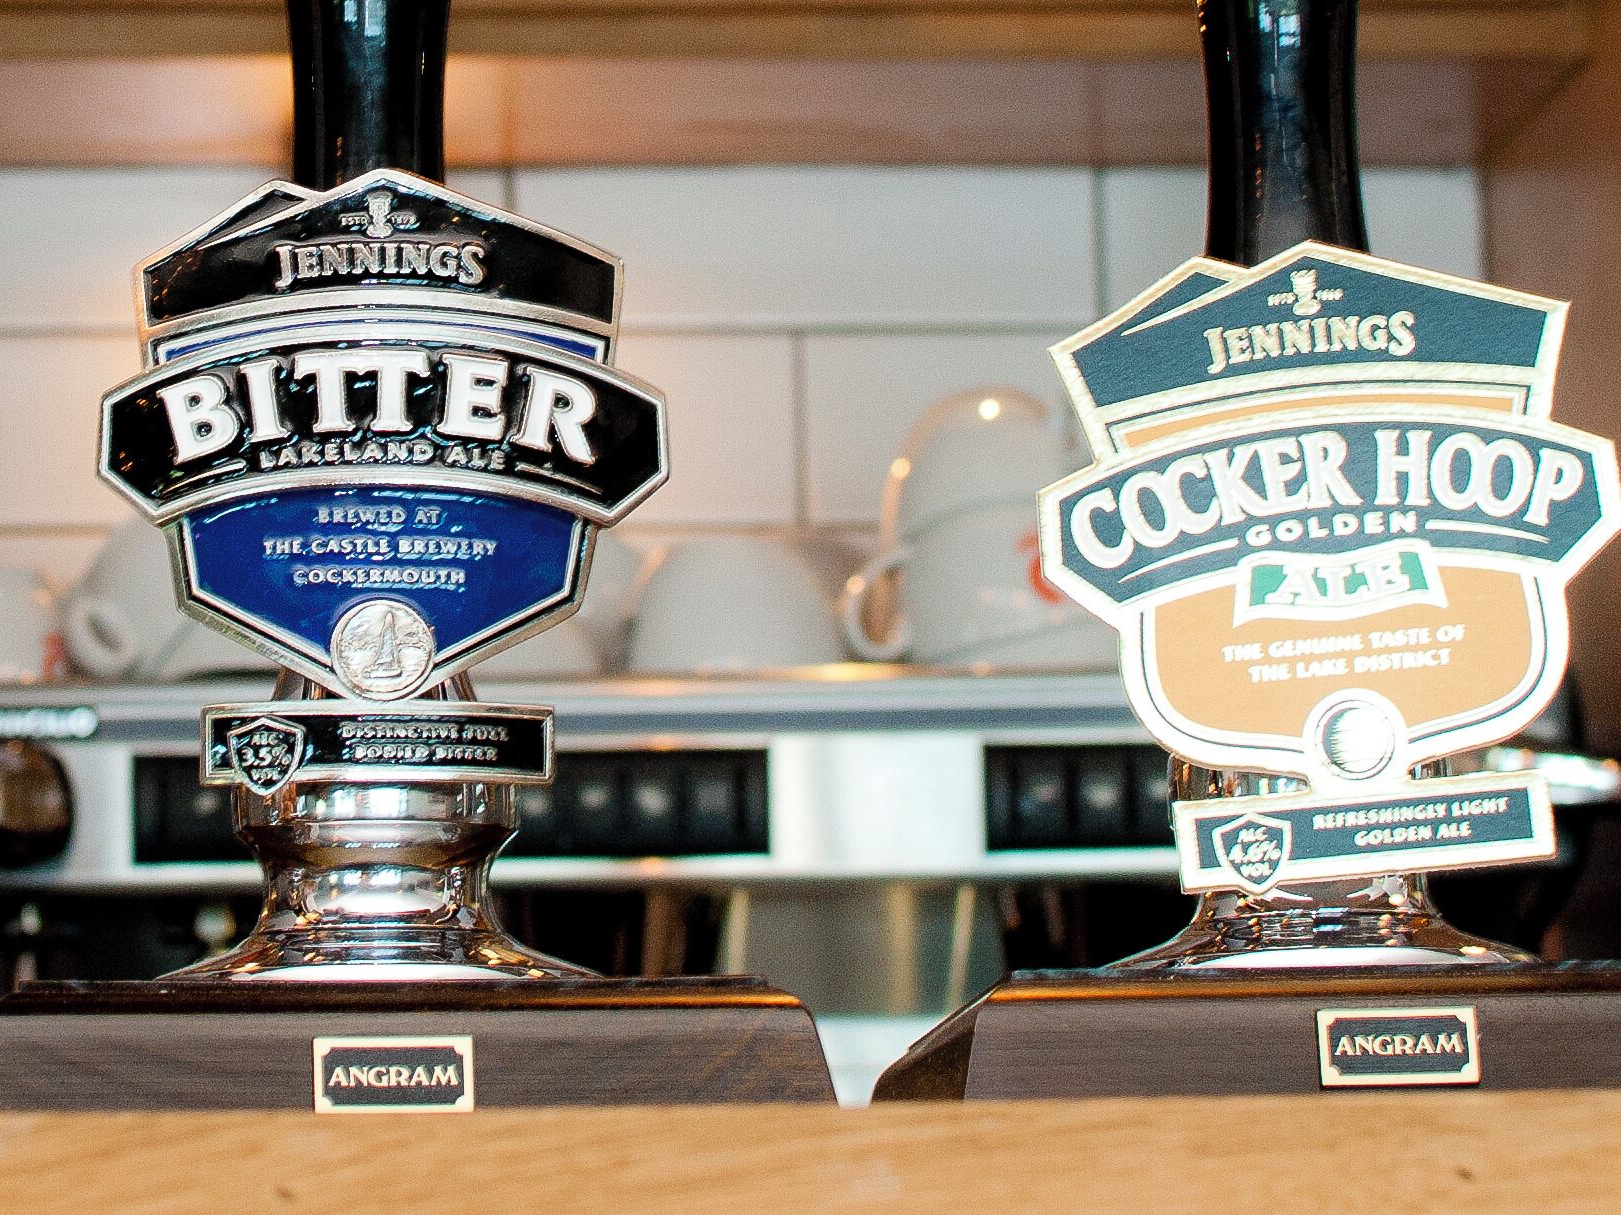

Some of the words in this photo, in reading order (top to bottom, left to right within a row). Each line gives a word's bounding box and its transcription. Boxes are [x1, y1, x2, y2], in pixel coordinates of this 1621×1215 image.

[275, 243, 485, 288] JENNINGS
[1204, 310, 1417, 374] JENNINGS
[157, 352, 597, 466] BITTER
[259, 441, 434, 469] LAKELAND
[445, 446, 507, 470] ALE
[318, 507, 406, 524] BREWED
[413, 508, 441, 524] AT
[1070, 430, 1363, 569] COCKER
[1373, 429, 1584, 527] HOOP
[1245, 511, 1418, 547] GOLDEN
[263, 539, 303, 555] THE
[311, 538, 390, 555] CASTLE
[398, 538, 497, 557] BREWERY
[292, 567, 467, 585] COCKERMOUTH
[1265, 554, 1413, 606] ALE
[1221, 643, 1265, 663] THE
[1268, 634, 1365, 659] GENUINE
[1368, 627, 1432, 649] TASTE
[1435, 623, 1466, 643] OF
[1248, 663, 1293, 684] THE
[1296, 658, 1349, 679] LAKE
[1354, 648, 1452, 674] DISTRICT
[241, 744, 292, 768] 3.5%
[1312, 802, 1448, 830] REFRESHINGLY
[1451, 796, 1509, 818] LIGHT
[1353, 824, 1434, 847] GOLDEN
[1436, 820, 1473, 841] ALE
[1334, 1033, 1464, 1057] ANGRAM
[329, 1066, 458, 1088] ANGRAM
